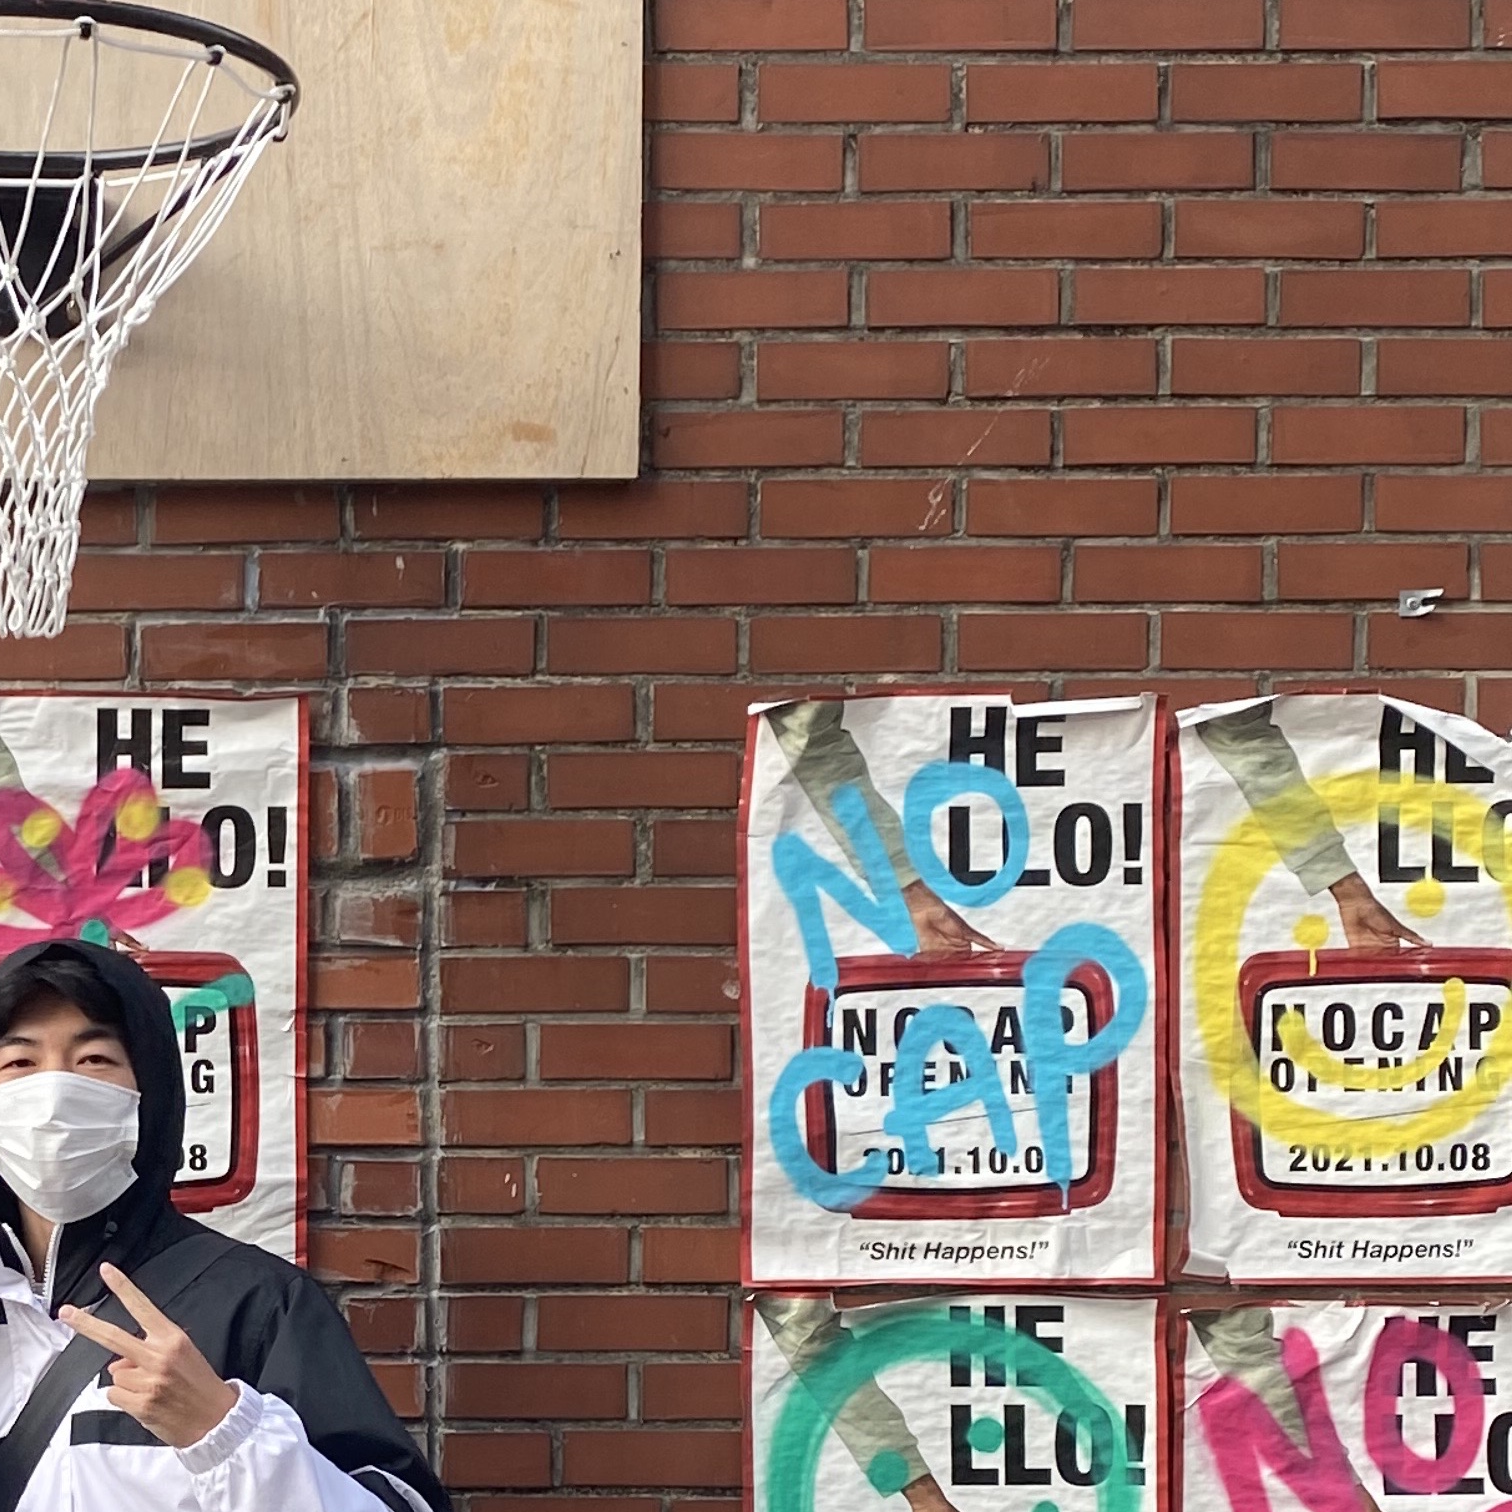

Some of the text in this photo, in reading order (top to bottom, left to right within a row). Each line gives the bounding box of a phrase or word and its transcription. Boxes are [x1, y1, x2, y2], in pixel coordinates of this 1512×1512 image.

[97, 708, 211, 789] HE
[949, 706, 1066, 788] HE
[772, 759, 1030, 1000] NO
[770, 922, 1148, 1208] CAP
[860, 1240, 1050, 1263] “Shit Happens!”
[1287, 1238, 1473, 1261] “Shit Happens!”
[950, 1404, 1146, 1486] LLO!
